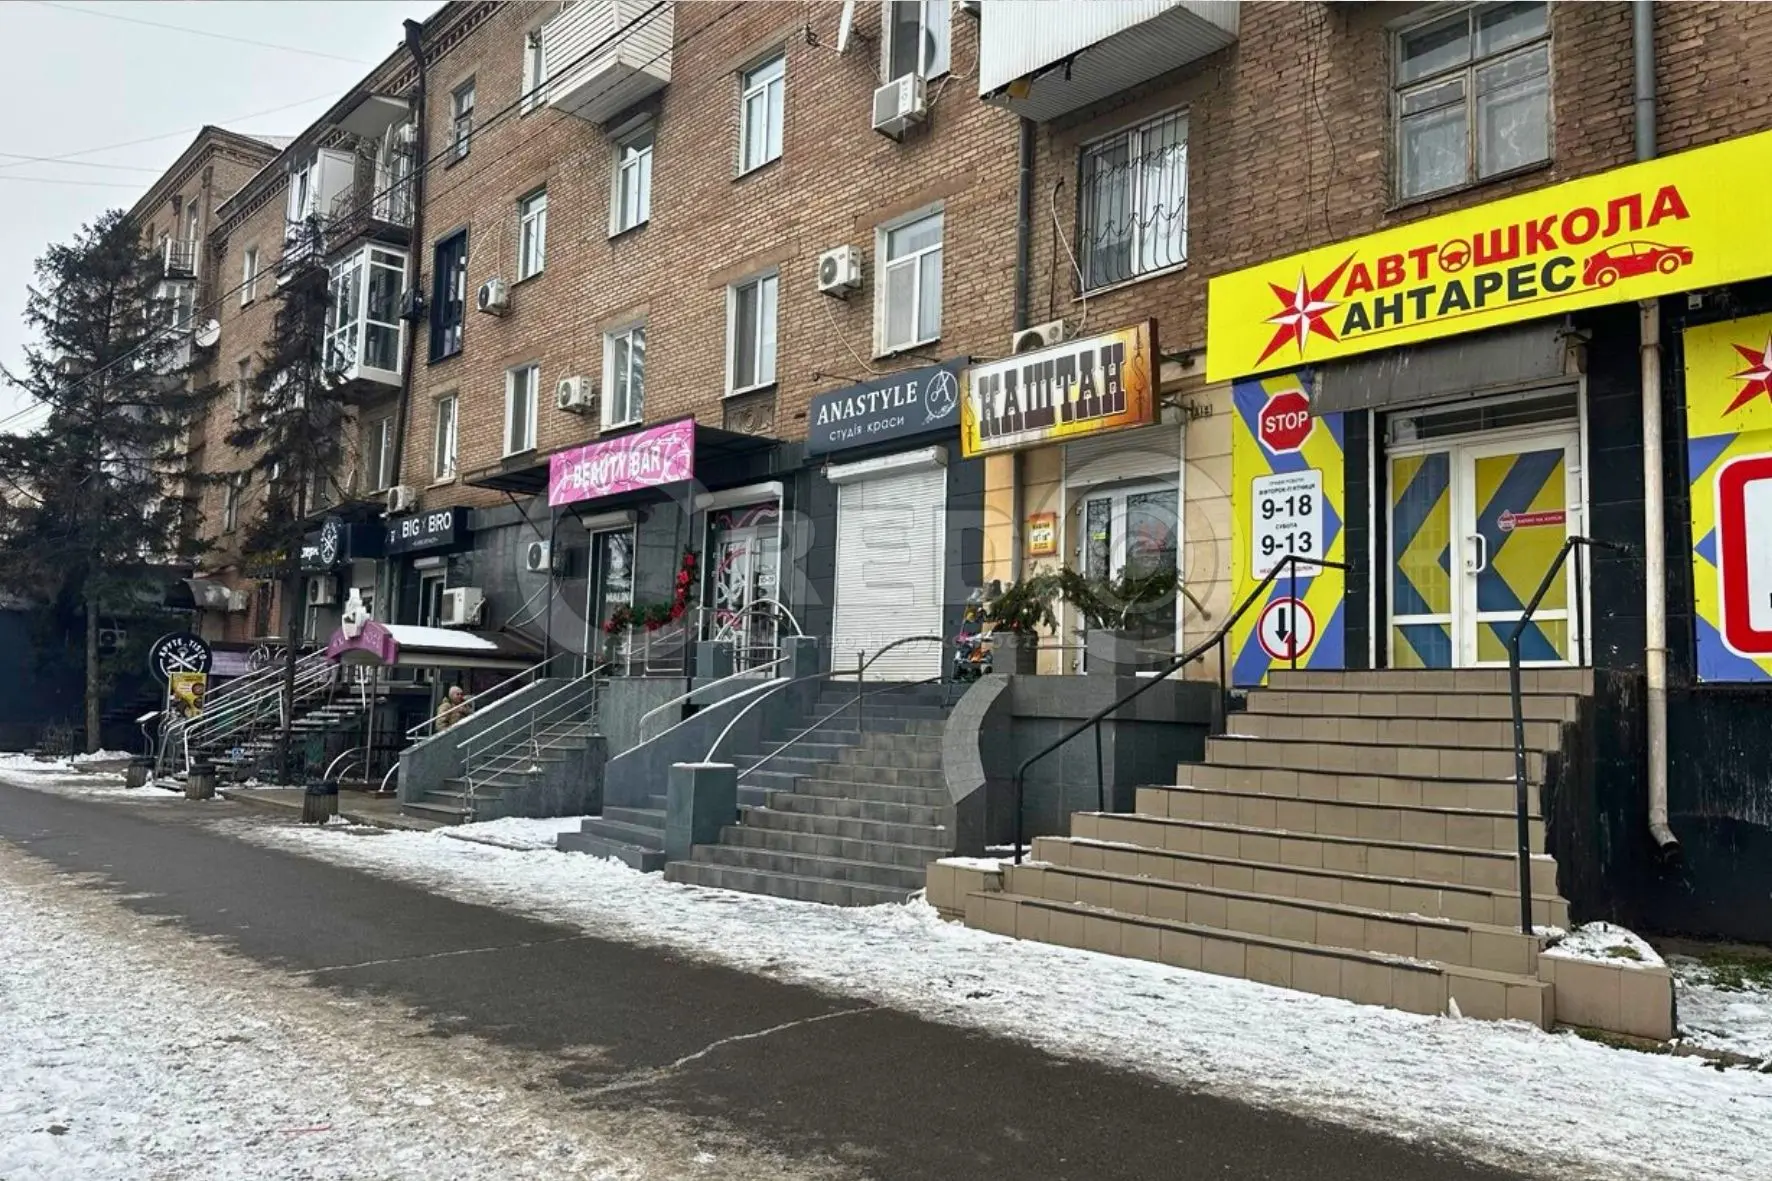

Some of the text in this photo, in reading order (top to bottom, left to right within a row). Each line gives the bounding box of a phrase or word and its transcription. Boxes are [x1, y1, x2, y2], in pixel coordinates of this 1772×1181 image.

[1344, 184, 1690, 297] АВТОШКОЛА
[1340, 256, 1576, 337] АНТАРЕС
[816, 381, 918, 426] ANASTYLE
[977, 342, 1127, 438] КАШТАН
[829, 416, 905, 441] студія краси
[1265, 410, 1309, 434] STOP
[572, 446, 662, 488] BEAUTY BAR
[1261, 494, 1313, 520] 9-18
[402, 511, 452, 539] BIG BRO
[1261, 531, 1313, 556] 9-13
